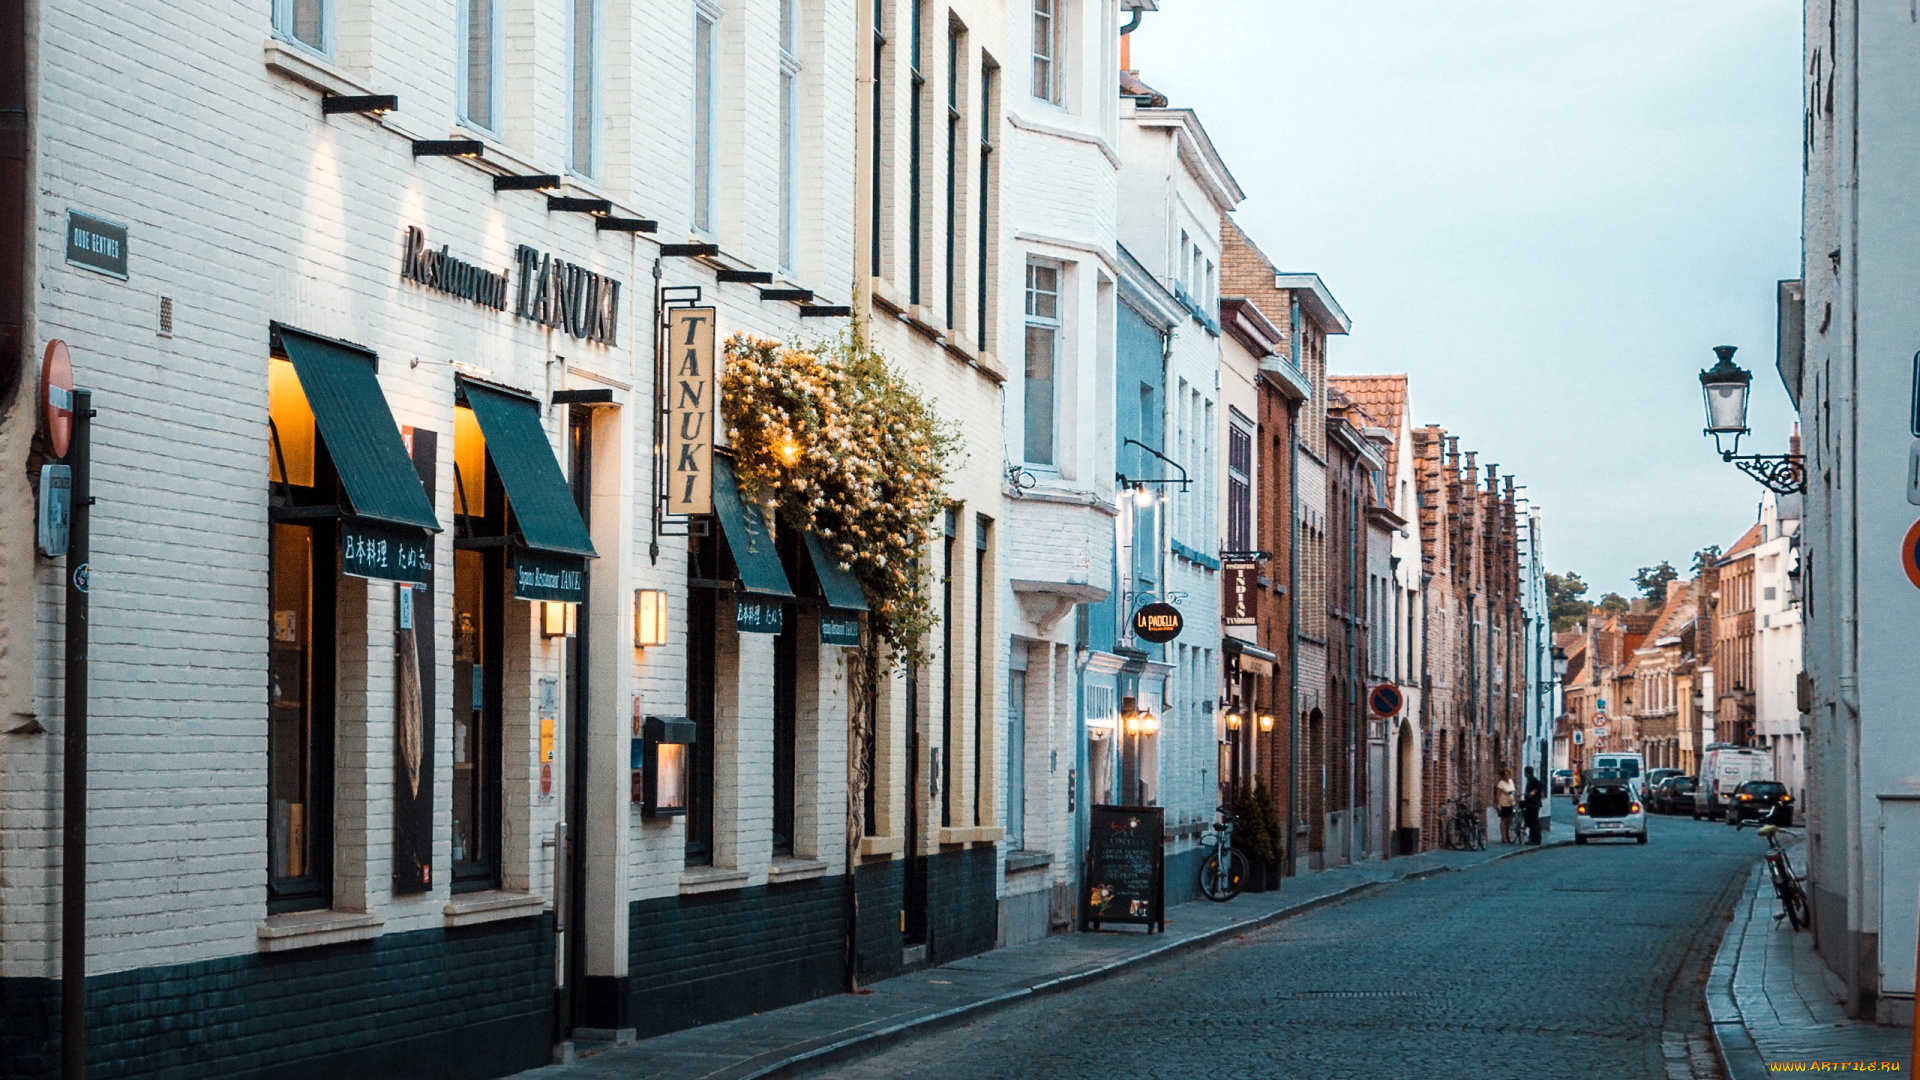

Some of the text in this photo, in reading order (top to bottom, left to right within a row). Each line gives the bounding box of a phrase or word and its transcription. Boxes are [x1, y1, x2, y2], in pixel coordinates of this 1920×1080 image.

[402, 225, 621, 347] Restaurant TANUKI
[677, 316, 707, 504] TANUKI
[345, 535, 388, 568] 日本料理
[1235, 569, 1247, 618] INDIAN
[1138, 612, 1178, 631] LA PADELLA
